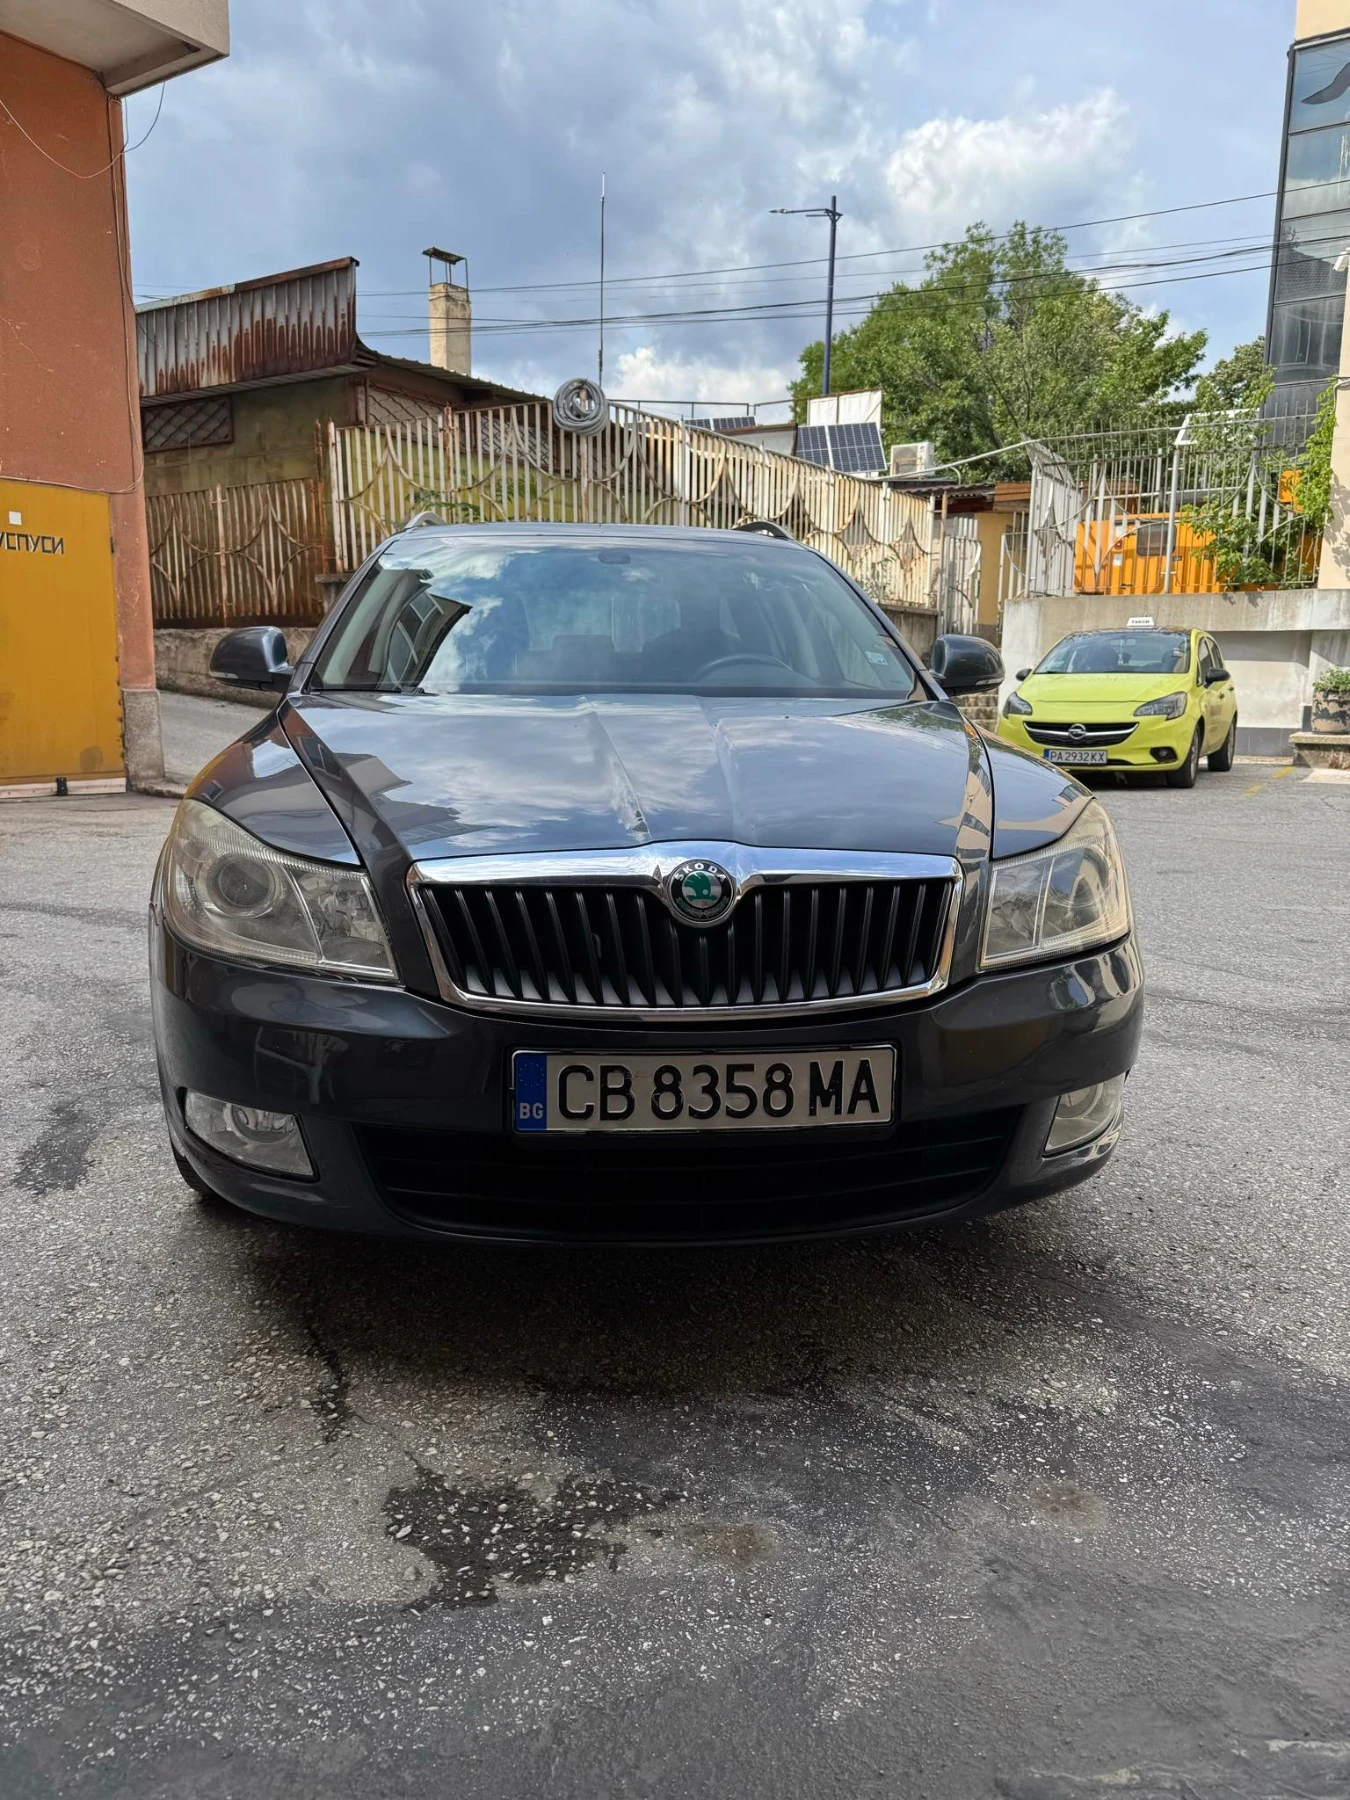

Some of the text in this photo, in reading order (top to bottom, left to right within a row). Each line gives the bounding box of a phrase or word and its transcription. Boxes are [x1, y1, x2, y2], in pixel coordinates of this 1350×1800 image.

[1050, 752, 1105, 762] PA 2932 KX
[558, 1058, 881, 1121] CB 8358 MA
[519, 1102, 544, 1119] BG
